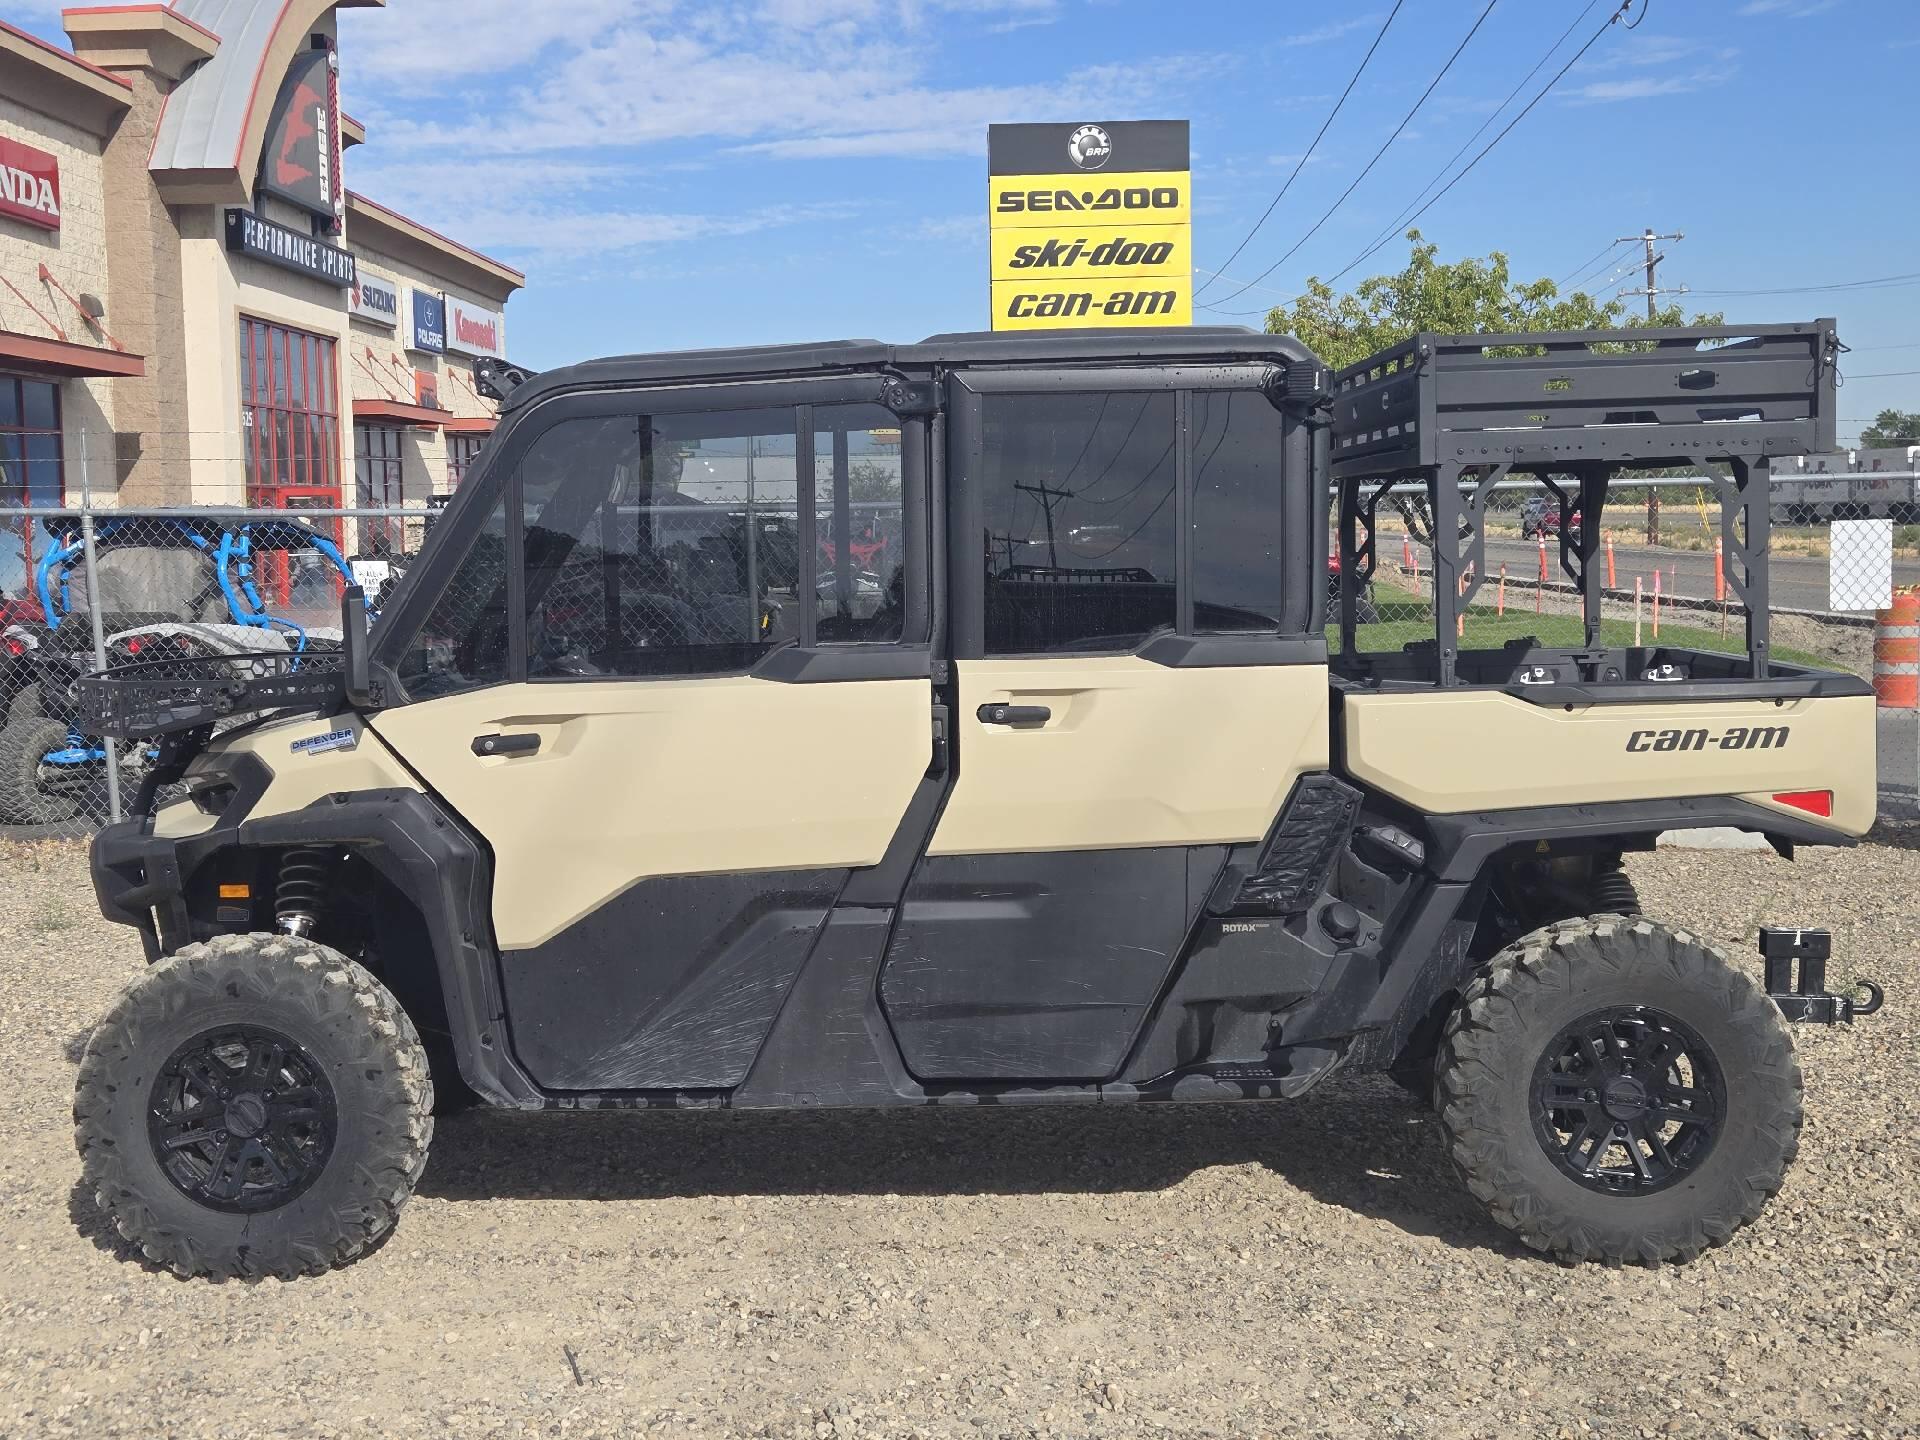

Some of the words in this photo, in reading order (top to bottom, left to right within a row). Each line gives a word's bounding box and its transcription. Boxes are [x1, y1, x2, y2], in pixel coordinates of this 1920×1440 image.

[1085, 147, 1110, 156] BRP
[244, 216, 317, 269] PERFORMANCE
[321, 248, 353, 281] SPORTS
[1008, 237, 1174, 269] ski-doo
[361, 284, 396, 316] SUZUKI
[1007, 290, 1177, 318] can-am
[417, 327, 443, 349] POLARIS
[454, 307, 497, 352] Kawasaki
[292, 729, 352, 750] DEFENDER
[1625, 726, 1790, 753] can-am
[1222, 923, 1256, 933] ROTAX
